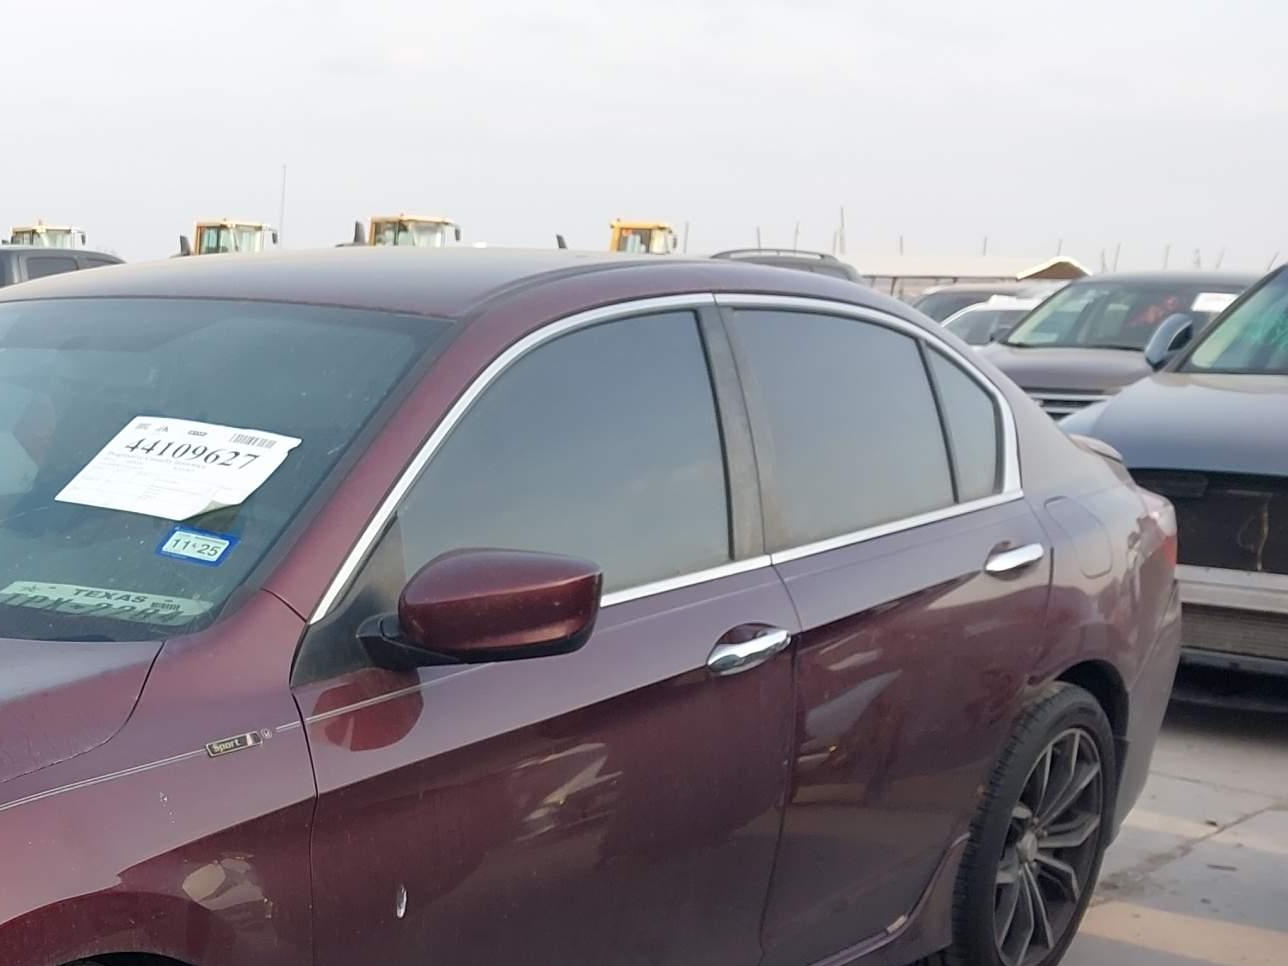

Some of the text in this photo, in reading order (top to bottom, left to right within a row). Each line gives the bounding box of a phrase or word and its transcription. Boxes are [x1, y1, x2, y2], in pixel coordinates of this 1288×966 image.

[125, 438, 260, 470] 44109627
[172, 539, 221, 556] 11 25
[73, 588, 149, 603] TEXAS
[212, 739, 241, 753] Sport
